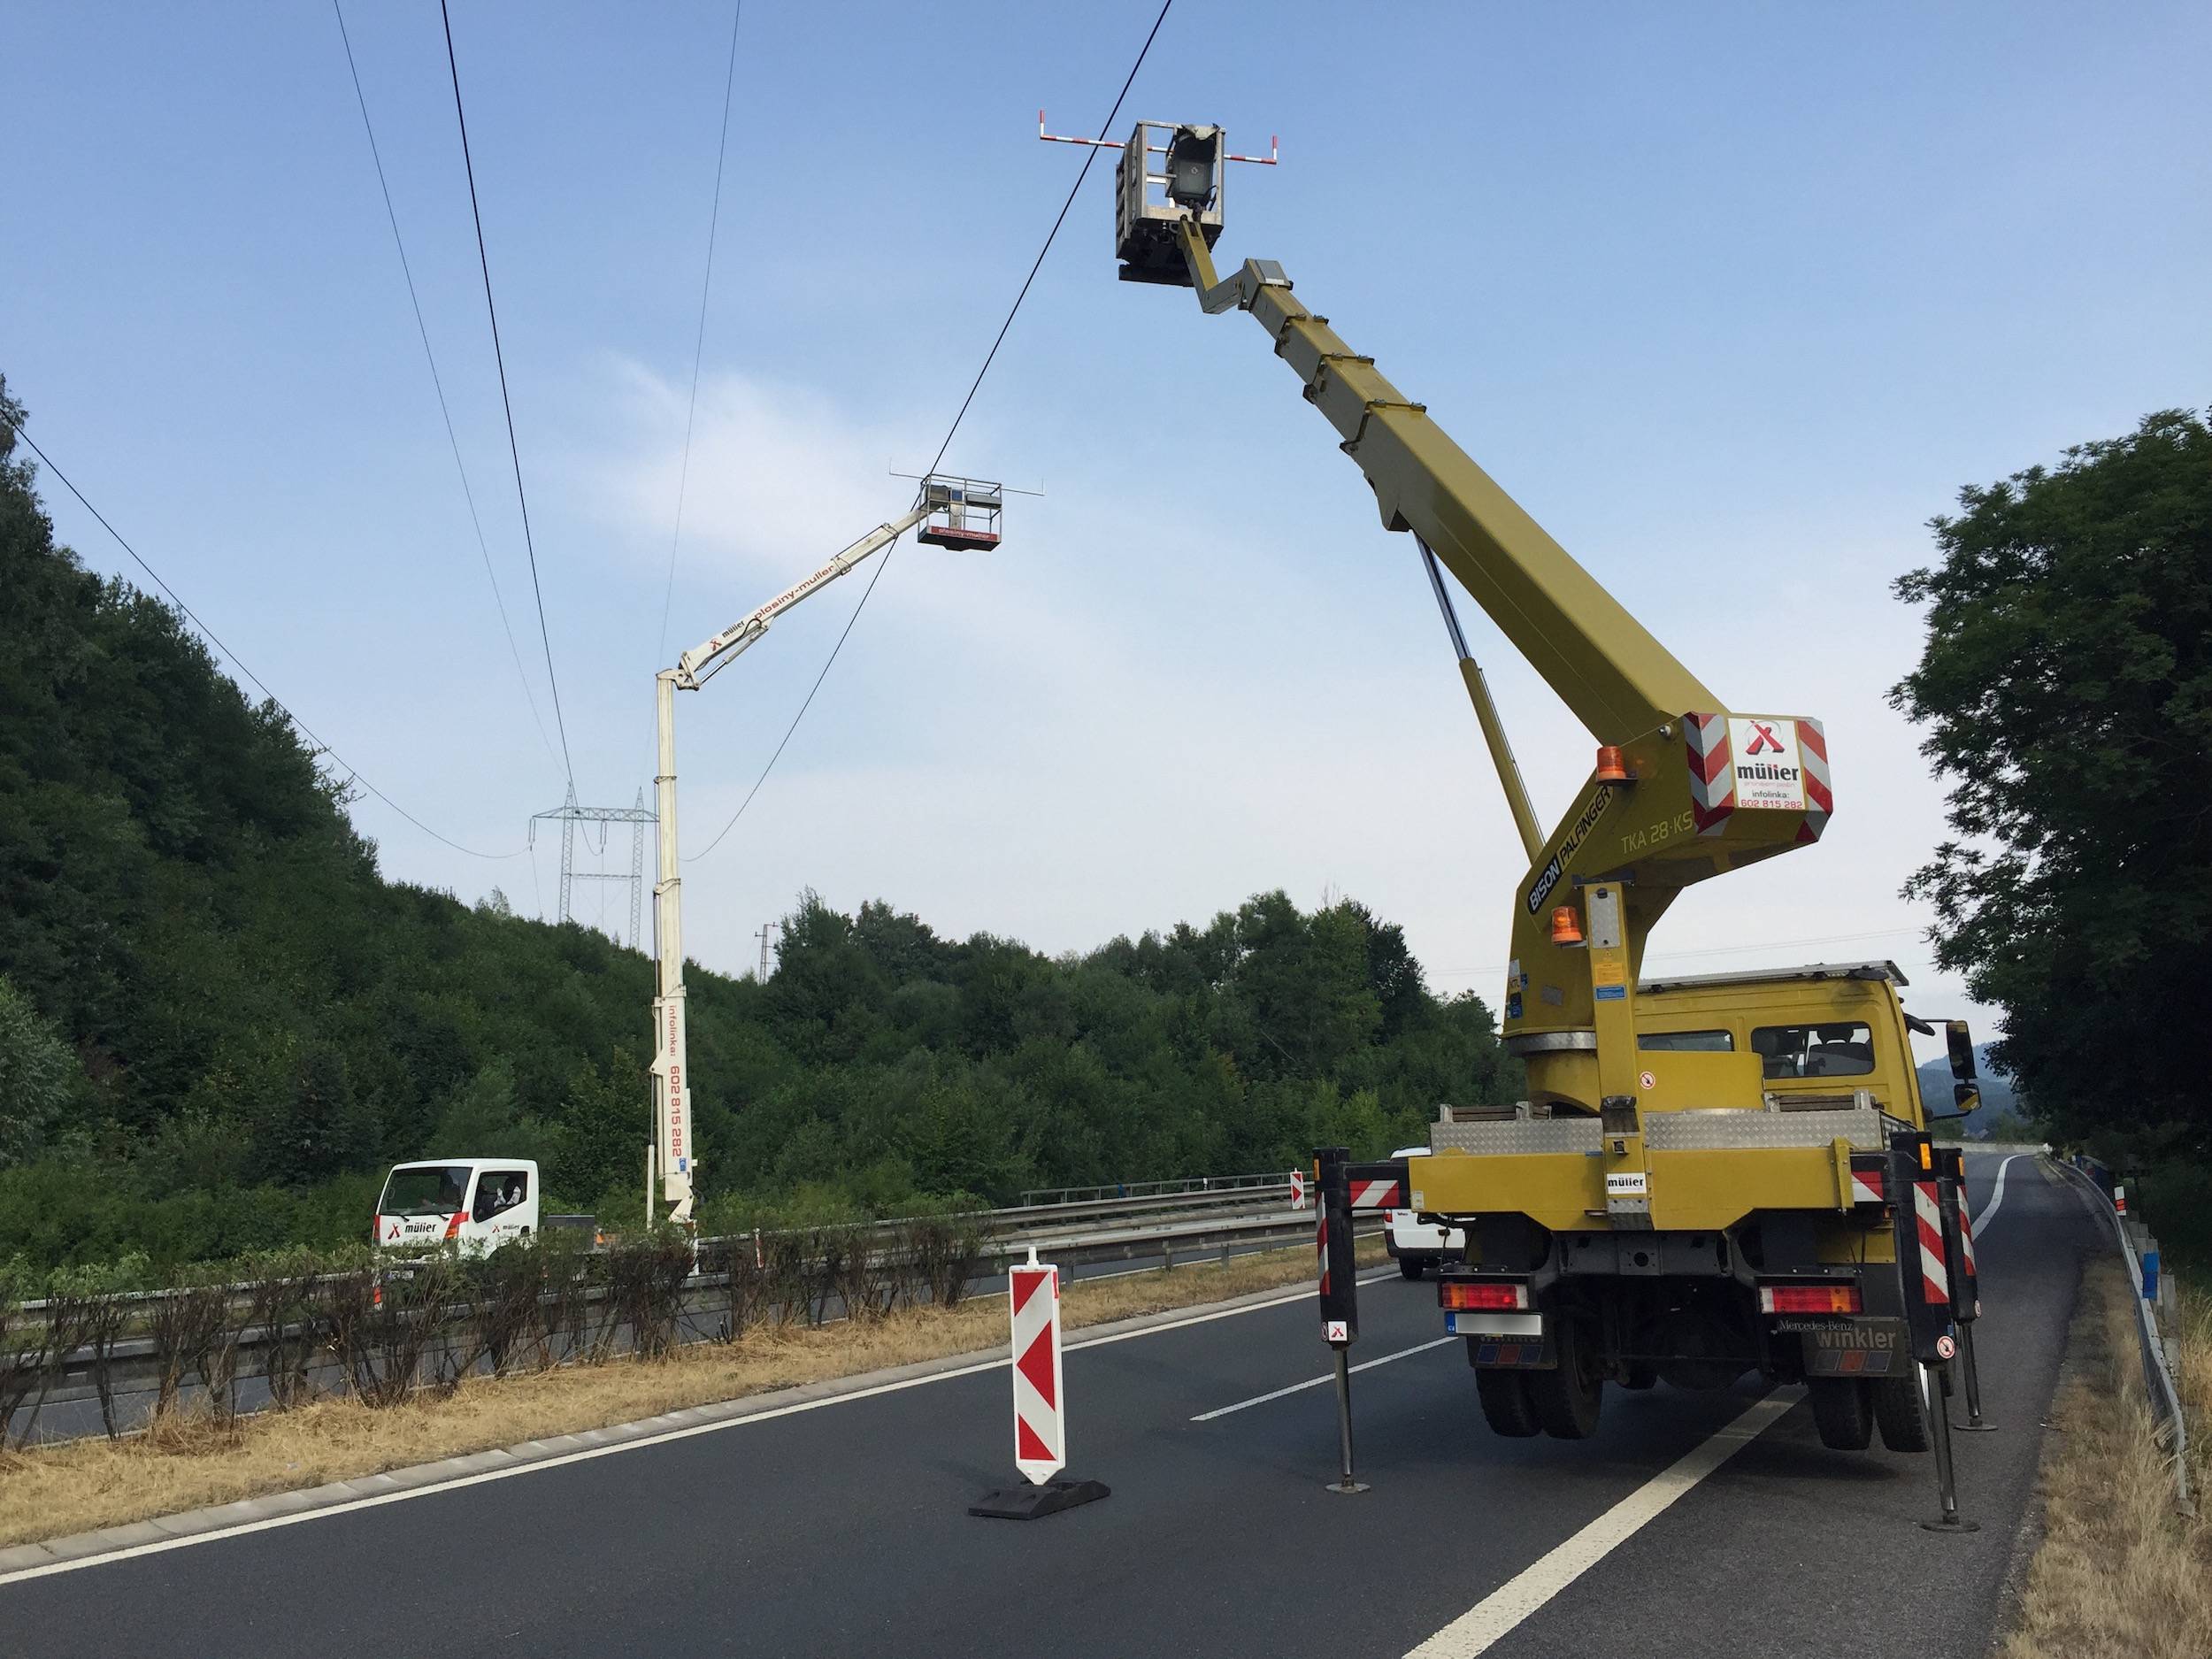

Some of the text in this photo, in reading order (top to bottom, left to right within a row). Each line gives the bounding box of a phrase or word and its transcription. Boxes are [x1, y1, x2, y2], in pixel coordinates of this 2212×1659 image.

[754, 565, 834, 620] plosiny-muller
[1737, 764, 1799, 781] müller
[1752, 789, 1790, 799] infolinka:
[1763, 800, 1782, 809] 815
[1529, 785, 1611, 910] BISON PALFINGER
[1620, 830, 1647, 855] TKA
[668, 1005, 682, 1157] infolinka: 602 815 282
[1608, 1177, 1644, 1187] müller
[404, 1222, 437, 1233] müller
[1778, 1319, 1855, 1332] Mercedes-Benz
[1816, 1327, 1897, 1349] winkler
